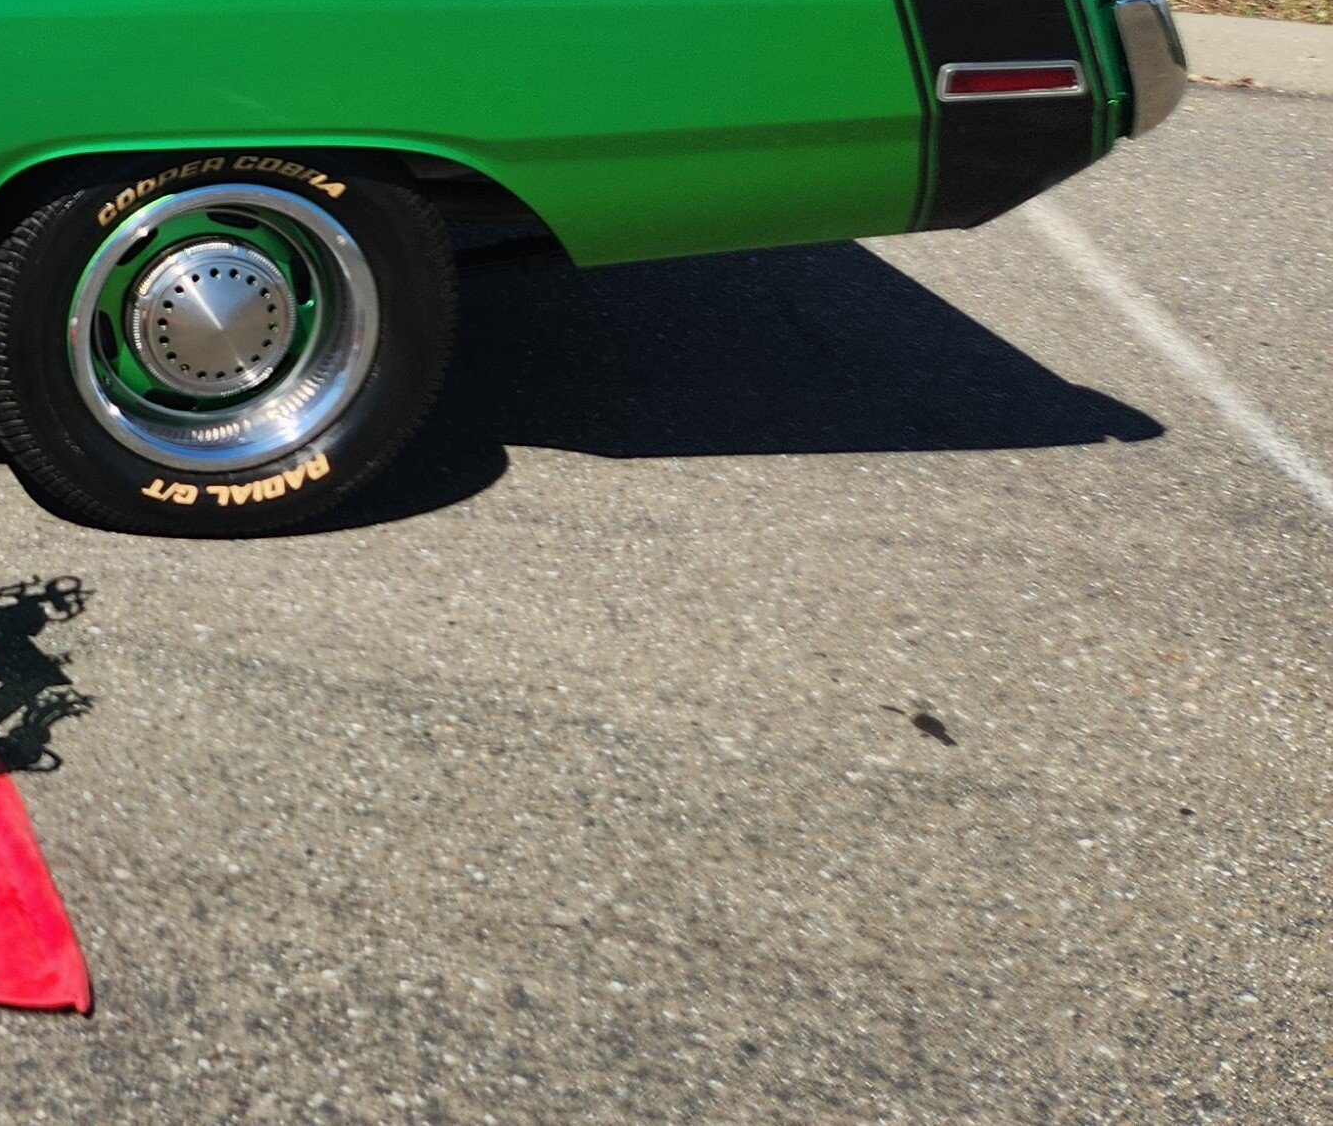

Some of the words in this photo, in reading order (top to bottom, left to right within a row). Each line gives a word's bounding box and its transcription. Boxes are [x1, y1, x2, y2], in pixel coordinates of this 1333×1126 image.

[97, 155, 225, 228] COOPER
[233, 155, 348, 200] COBRA
[141, 478, 198, 506] G/T
[205, 452, 332, 507] RADIAL
